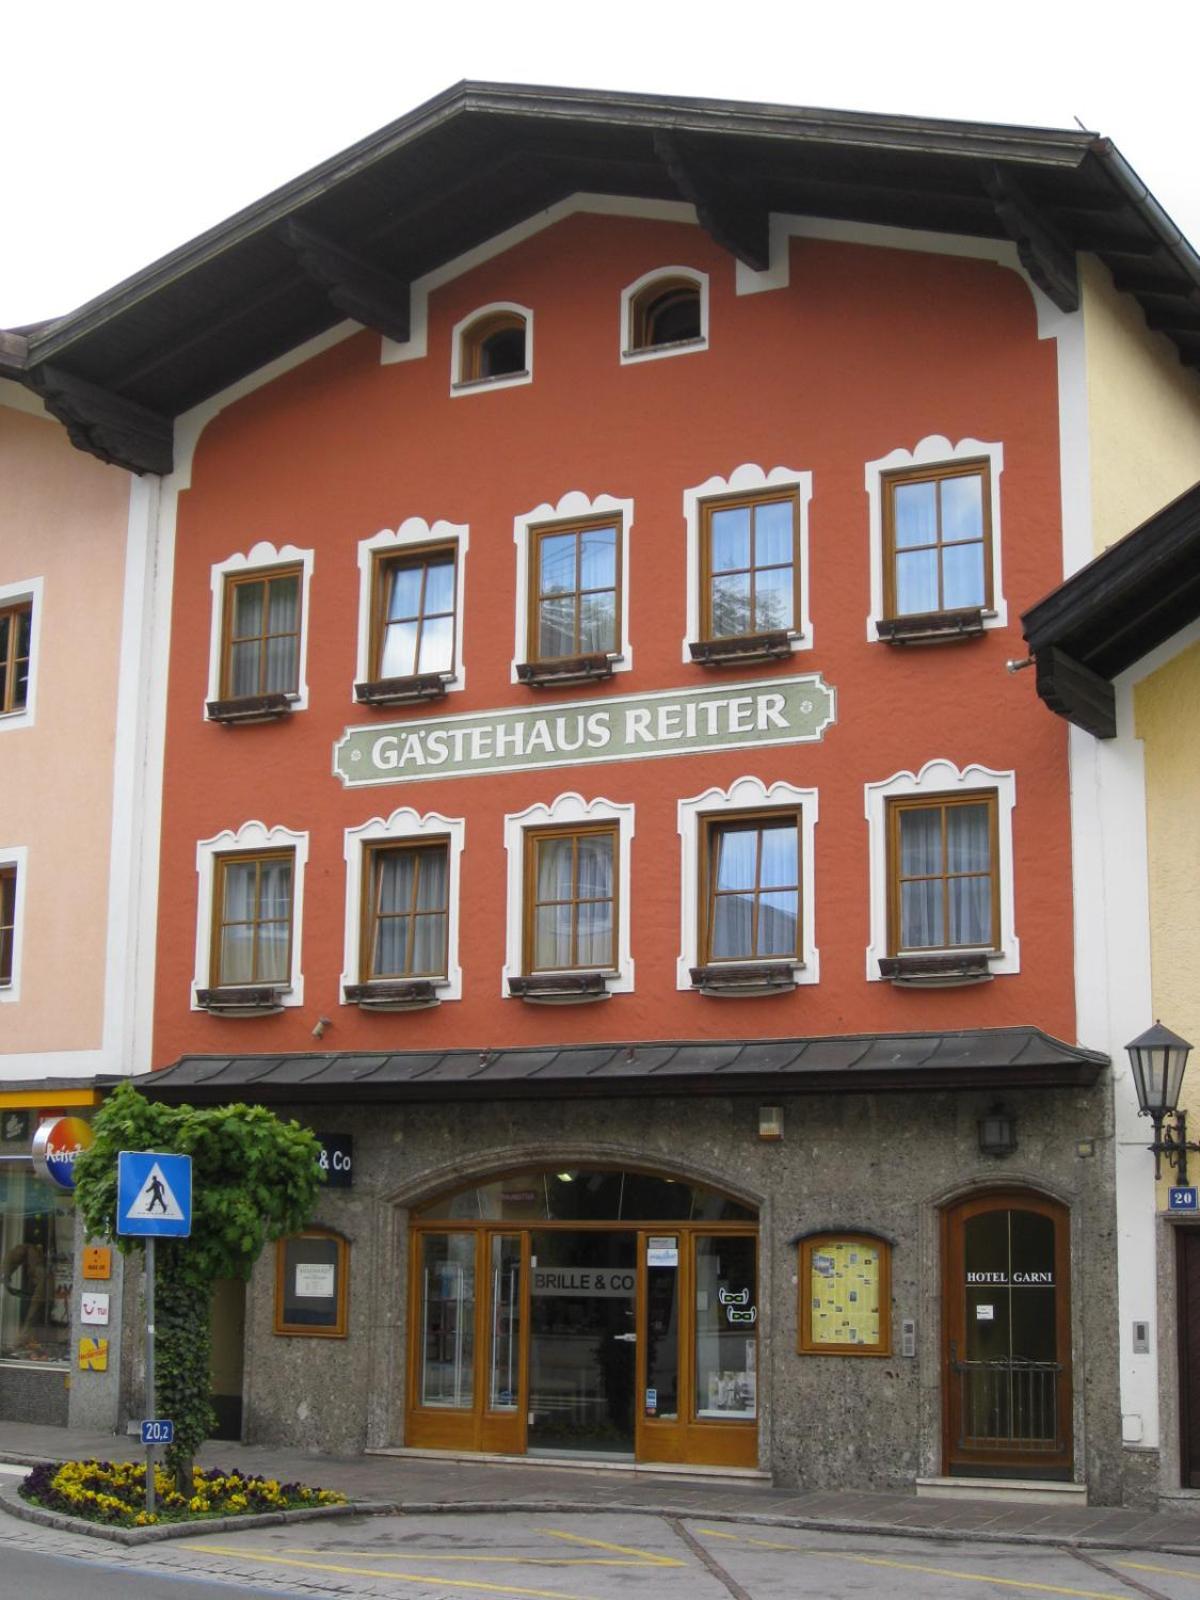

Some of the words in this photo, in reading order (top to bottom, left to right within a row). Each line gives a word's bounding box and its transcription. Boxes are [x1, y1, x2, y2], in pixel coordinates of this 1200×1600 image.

[372, 712, 611, 770] GÄSTEHAUS
[625, 693, 791, 744] REITER
[319, 1149, 330, 1170] &
[333, 1150, 351, 1171] Co
[1174, 1192, 1192, 1204] 20
[535, 1273, 591, 1290] BRILLE
[594, 1274, 606, 1290] &
[610, 1274, 634, 1291] CO
[967, 1272, 1008, 1282] HOTEL
[1013, 1272, 1053, 1282] GARNI
[146, 1423, 169, 1440] 20,2
